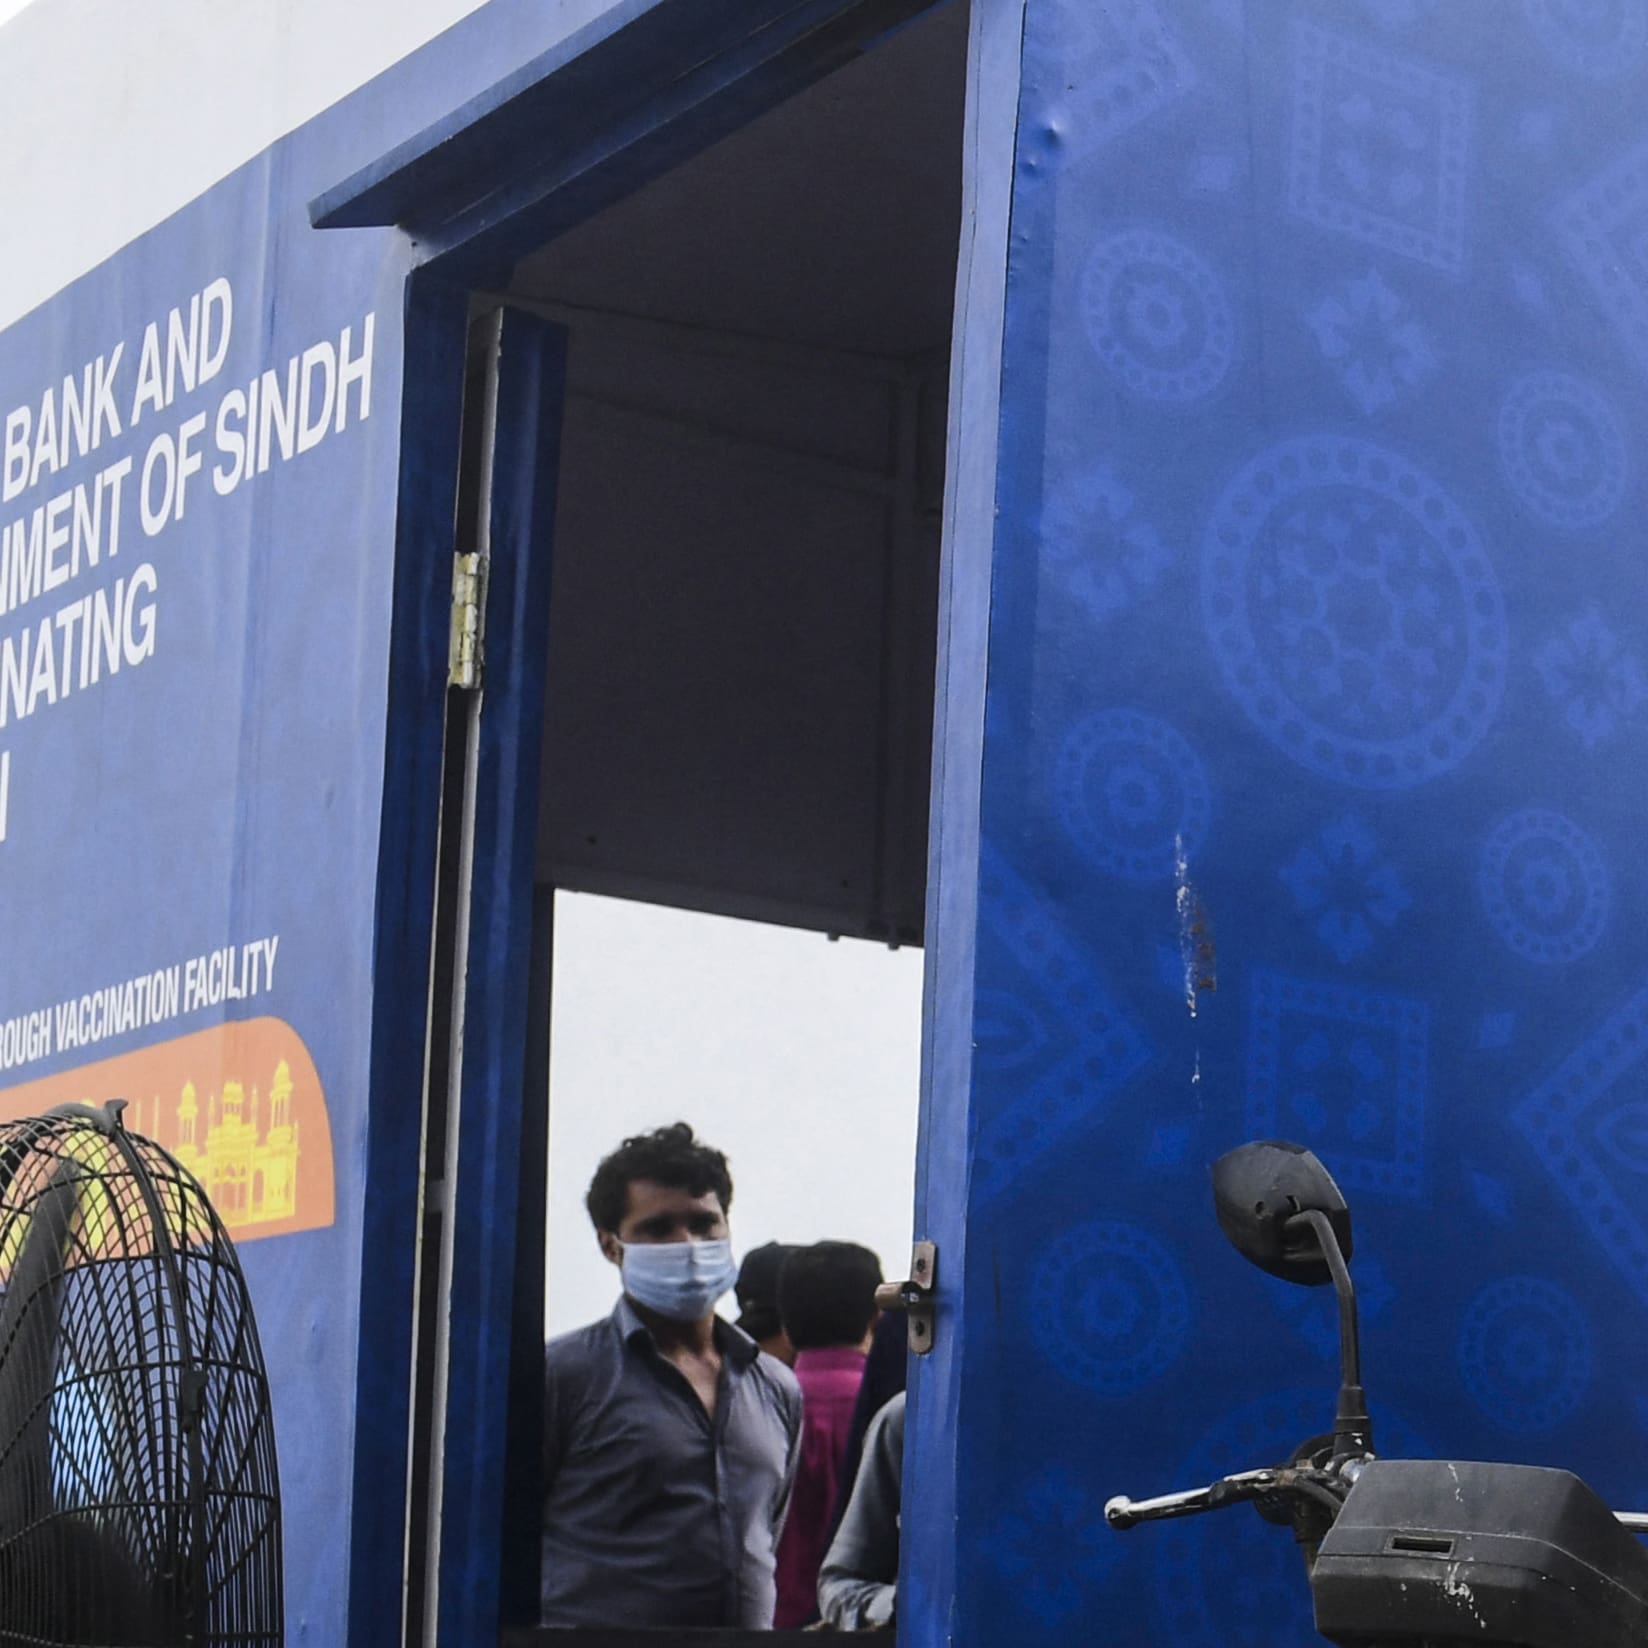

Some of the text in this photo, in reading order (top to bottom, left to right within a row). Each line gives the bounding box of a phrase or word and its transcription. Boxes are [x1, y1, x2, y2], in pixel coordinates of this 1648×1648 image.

[3, 277, 232, 502] BANK AND
[140, 410, 206, 537] OF
[211, 312, 376, 496] SINDH
[0, 563, 157, 729] NATING
[56, 966, 181, 1053] VACCINATION
[183, 936, 279, 1014] FACILITY
